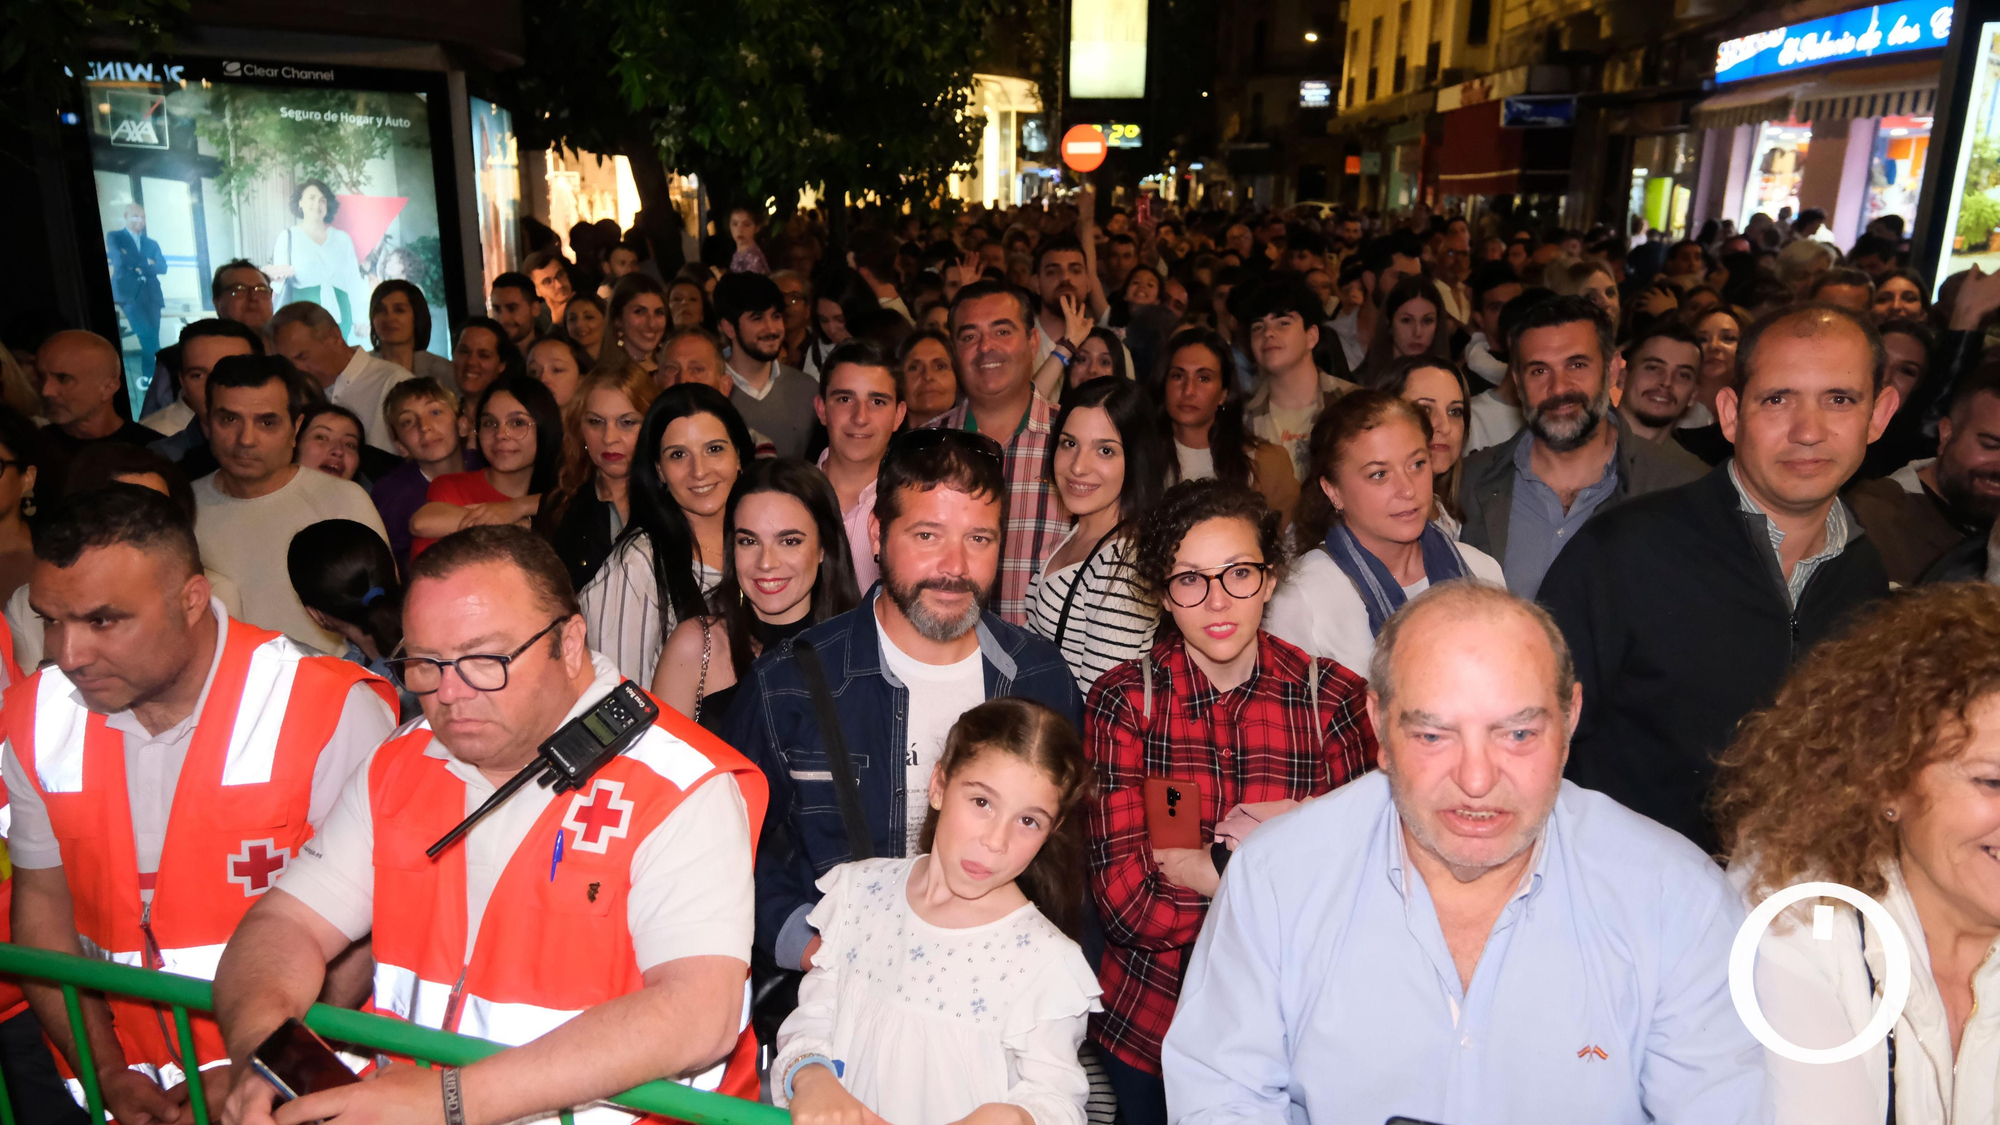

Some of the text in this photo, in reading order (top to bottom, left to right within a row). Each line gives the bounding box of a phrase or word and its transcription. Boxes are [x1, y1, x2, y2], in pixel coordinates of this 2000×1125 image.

[1856, 19, 1883, 52] de
[1887, 15, 1920, 46] los
[243, 63, 334, 81] Clear Channel
[279, 106, 411, 129] Seguro de Hogar y Auto
[111, 119, 159, 144] AXA
